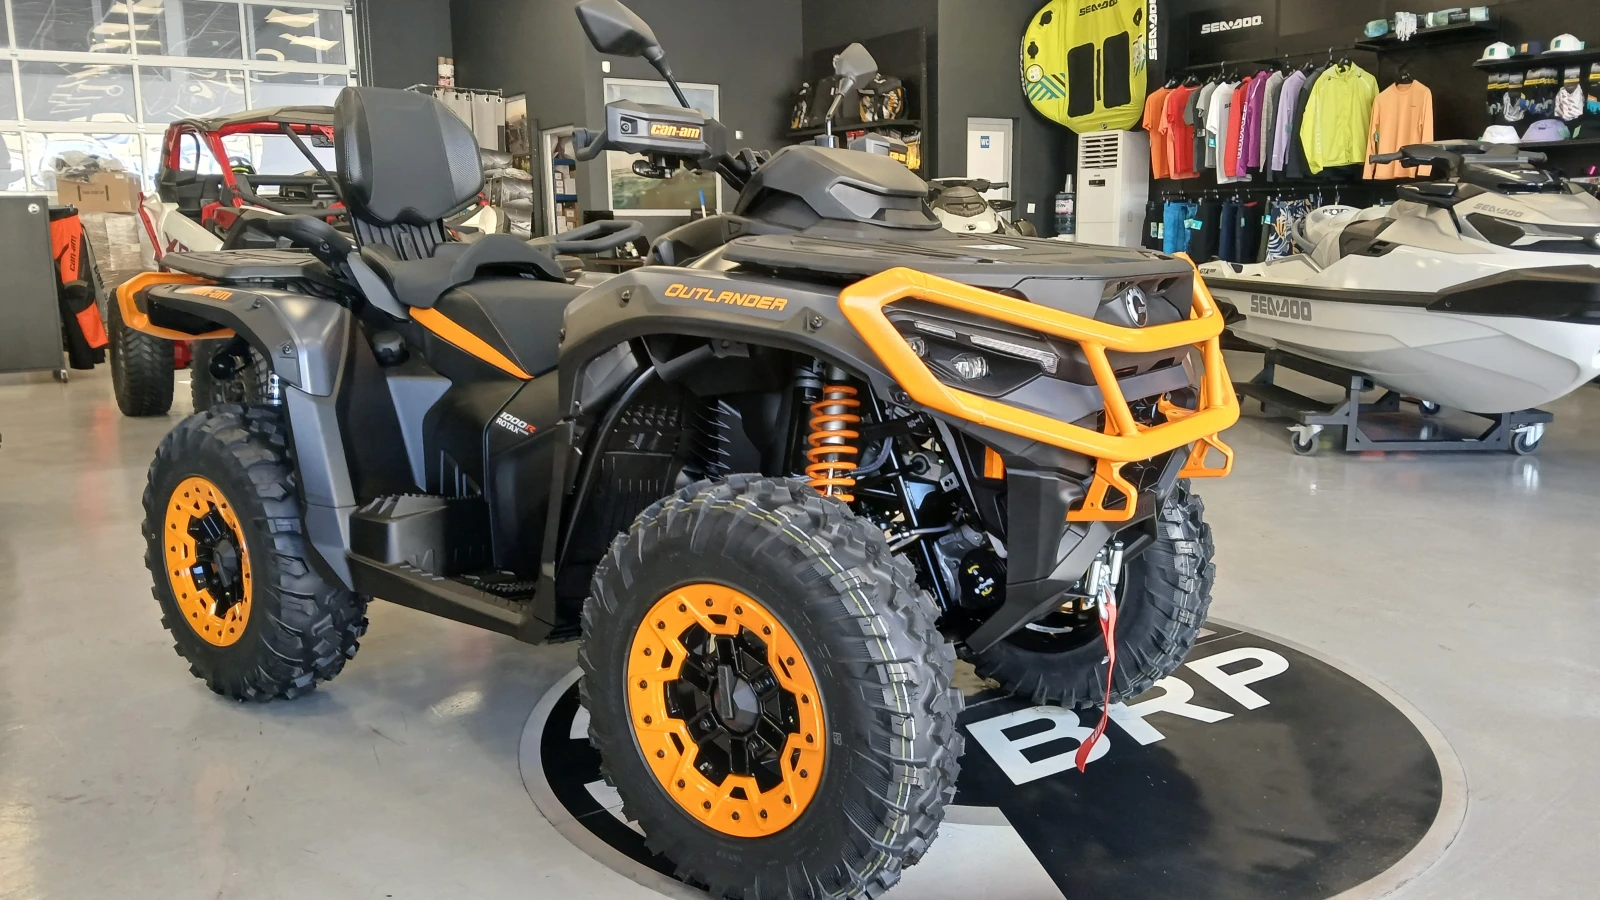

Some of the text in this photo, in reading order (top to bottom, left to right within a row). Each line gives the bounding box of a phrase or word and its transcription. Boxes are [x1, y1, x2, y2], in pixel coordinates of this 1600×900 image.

[651, 124, 700, 139] can-am
[981, 138, 990, 146] WC
[69, 235, 78, 272] can-am
[664, 283, 788, 311] OUTLANDER
[495, 417, 519, 434] ROTAX
[500, 412, 536, 433] 1000R
[965, 647, 1290, 785] BRP
